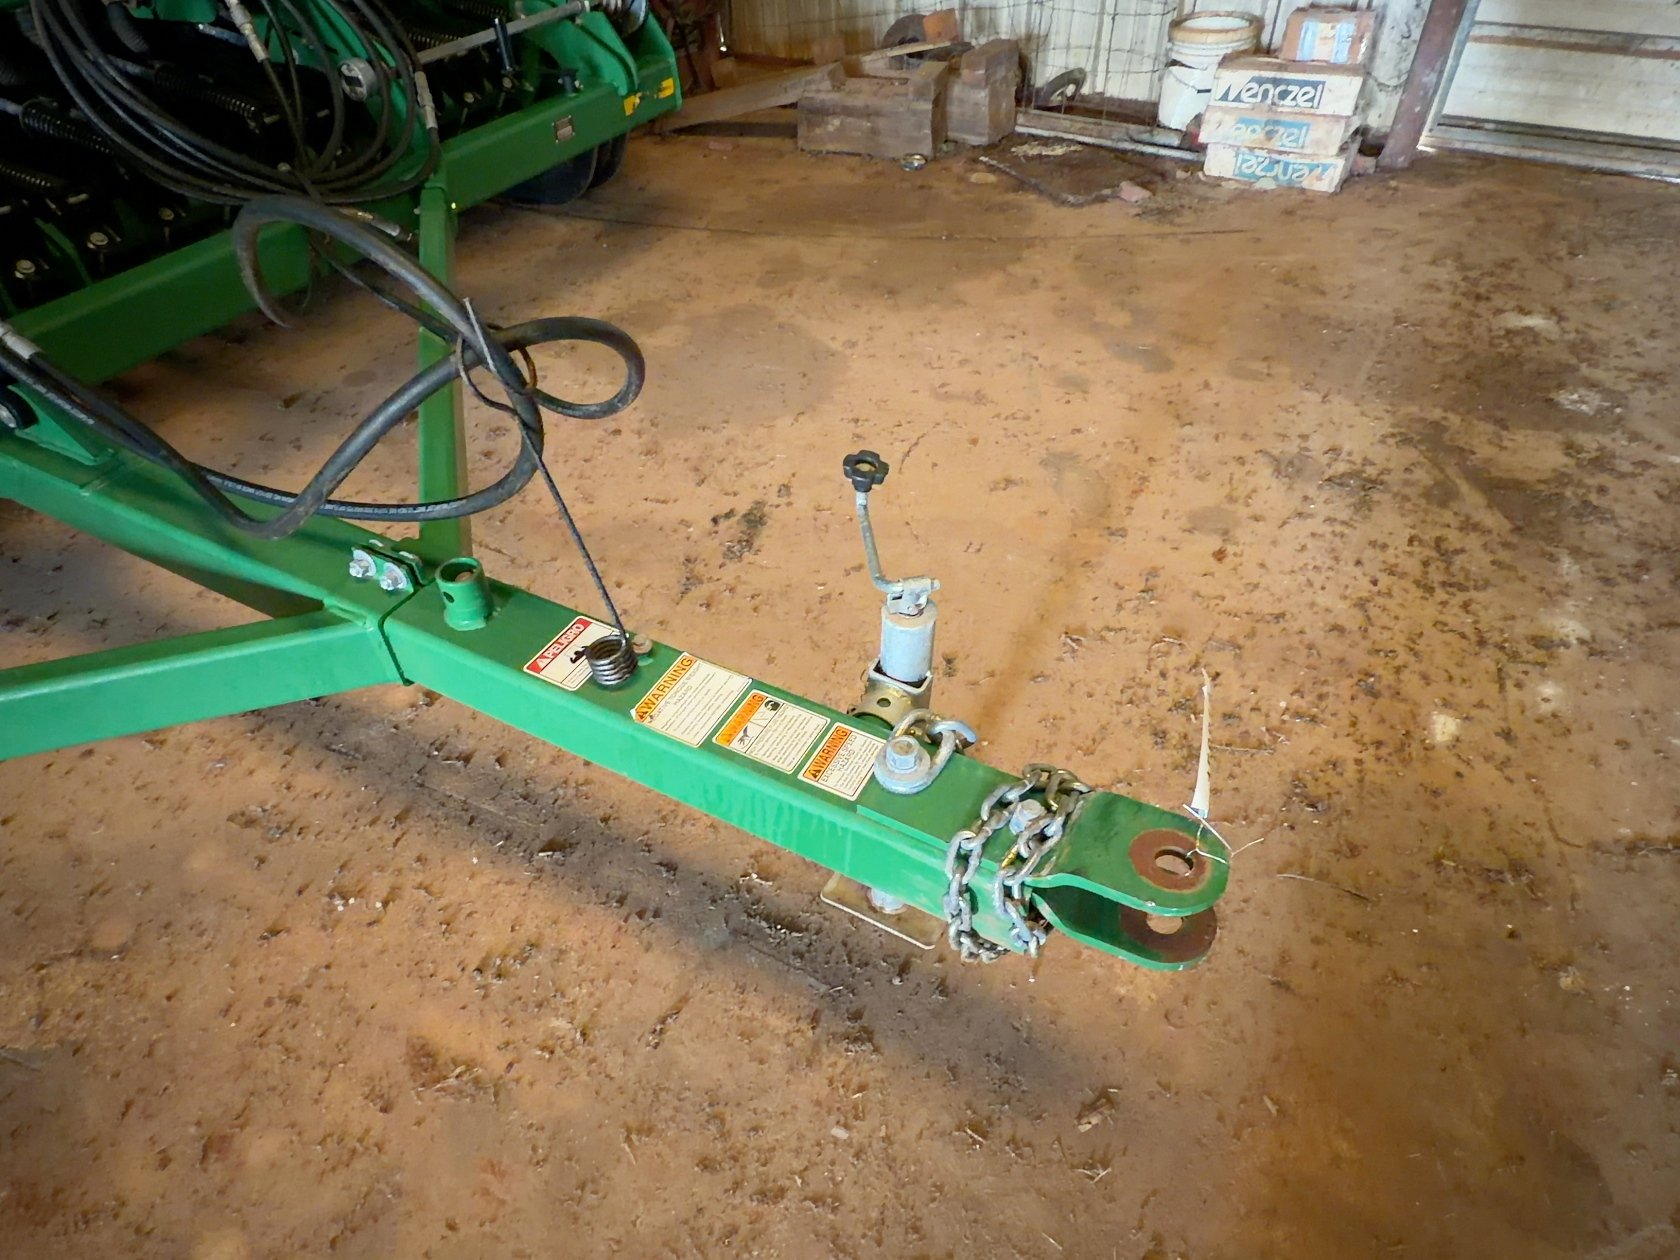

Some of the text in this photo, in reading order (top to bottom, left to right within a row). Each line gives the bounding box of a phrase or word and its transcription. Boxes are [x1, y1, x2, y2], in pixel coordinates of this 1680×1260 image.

[544, 622, 585, 661] PELIGRO
[642, 657, 693, 711] WARNING
[813, 727, 848, 769] WARNING
